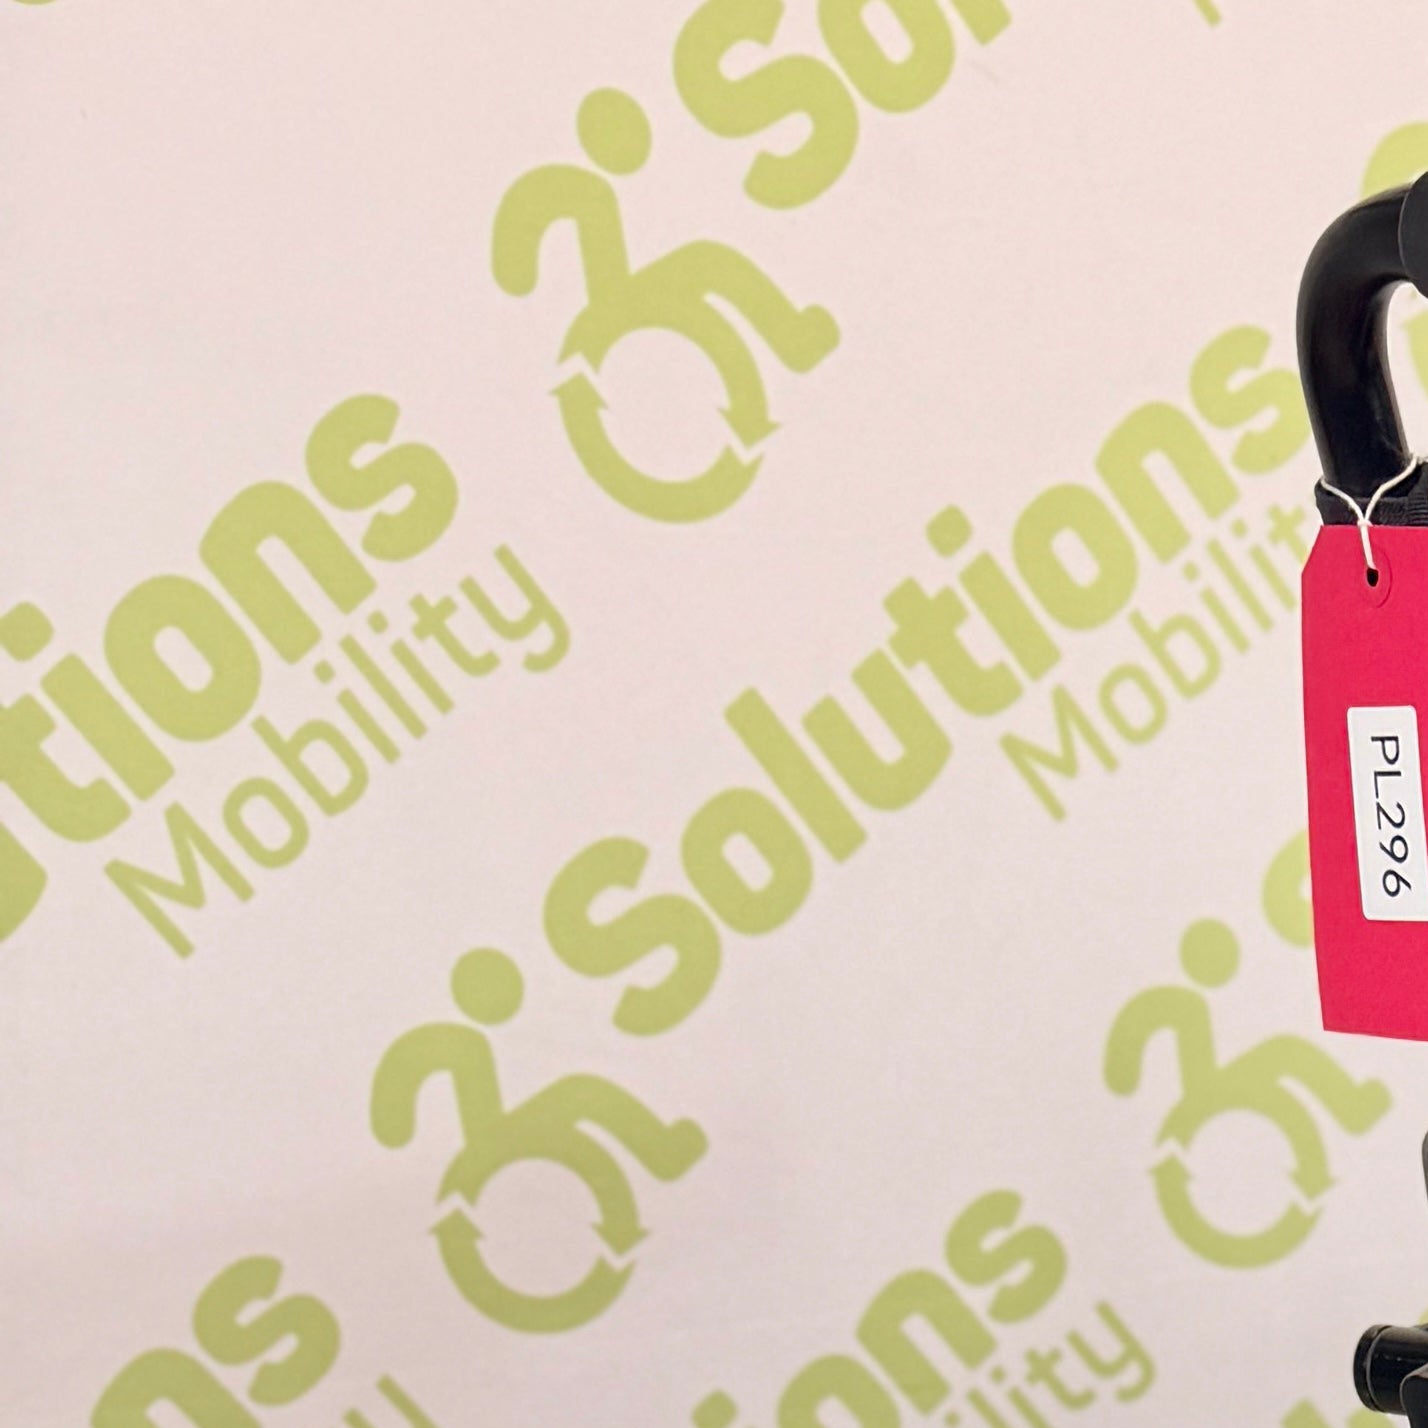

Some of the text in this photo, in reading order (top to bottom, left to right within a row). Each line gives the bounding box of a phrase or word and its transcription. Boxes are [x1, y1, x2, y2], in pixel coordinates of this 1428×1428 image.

[104, 543, 571, 960] Mobility
[542, 324, 1310, 1038] Solutions
[999, 502, 1306, 824] Mobilit
[1368, 734, 1413, 900] PL296
